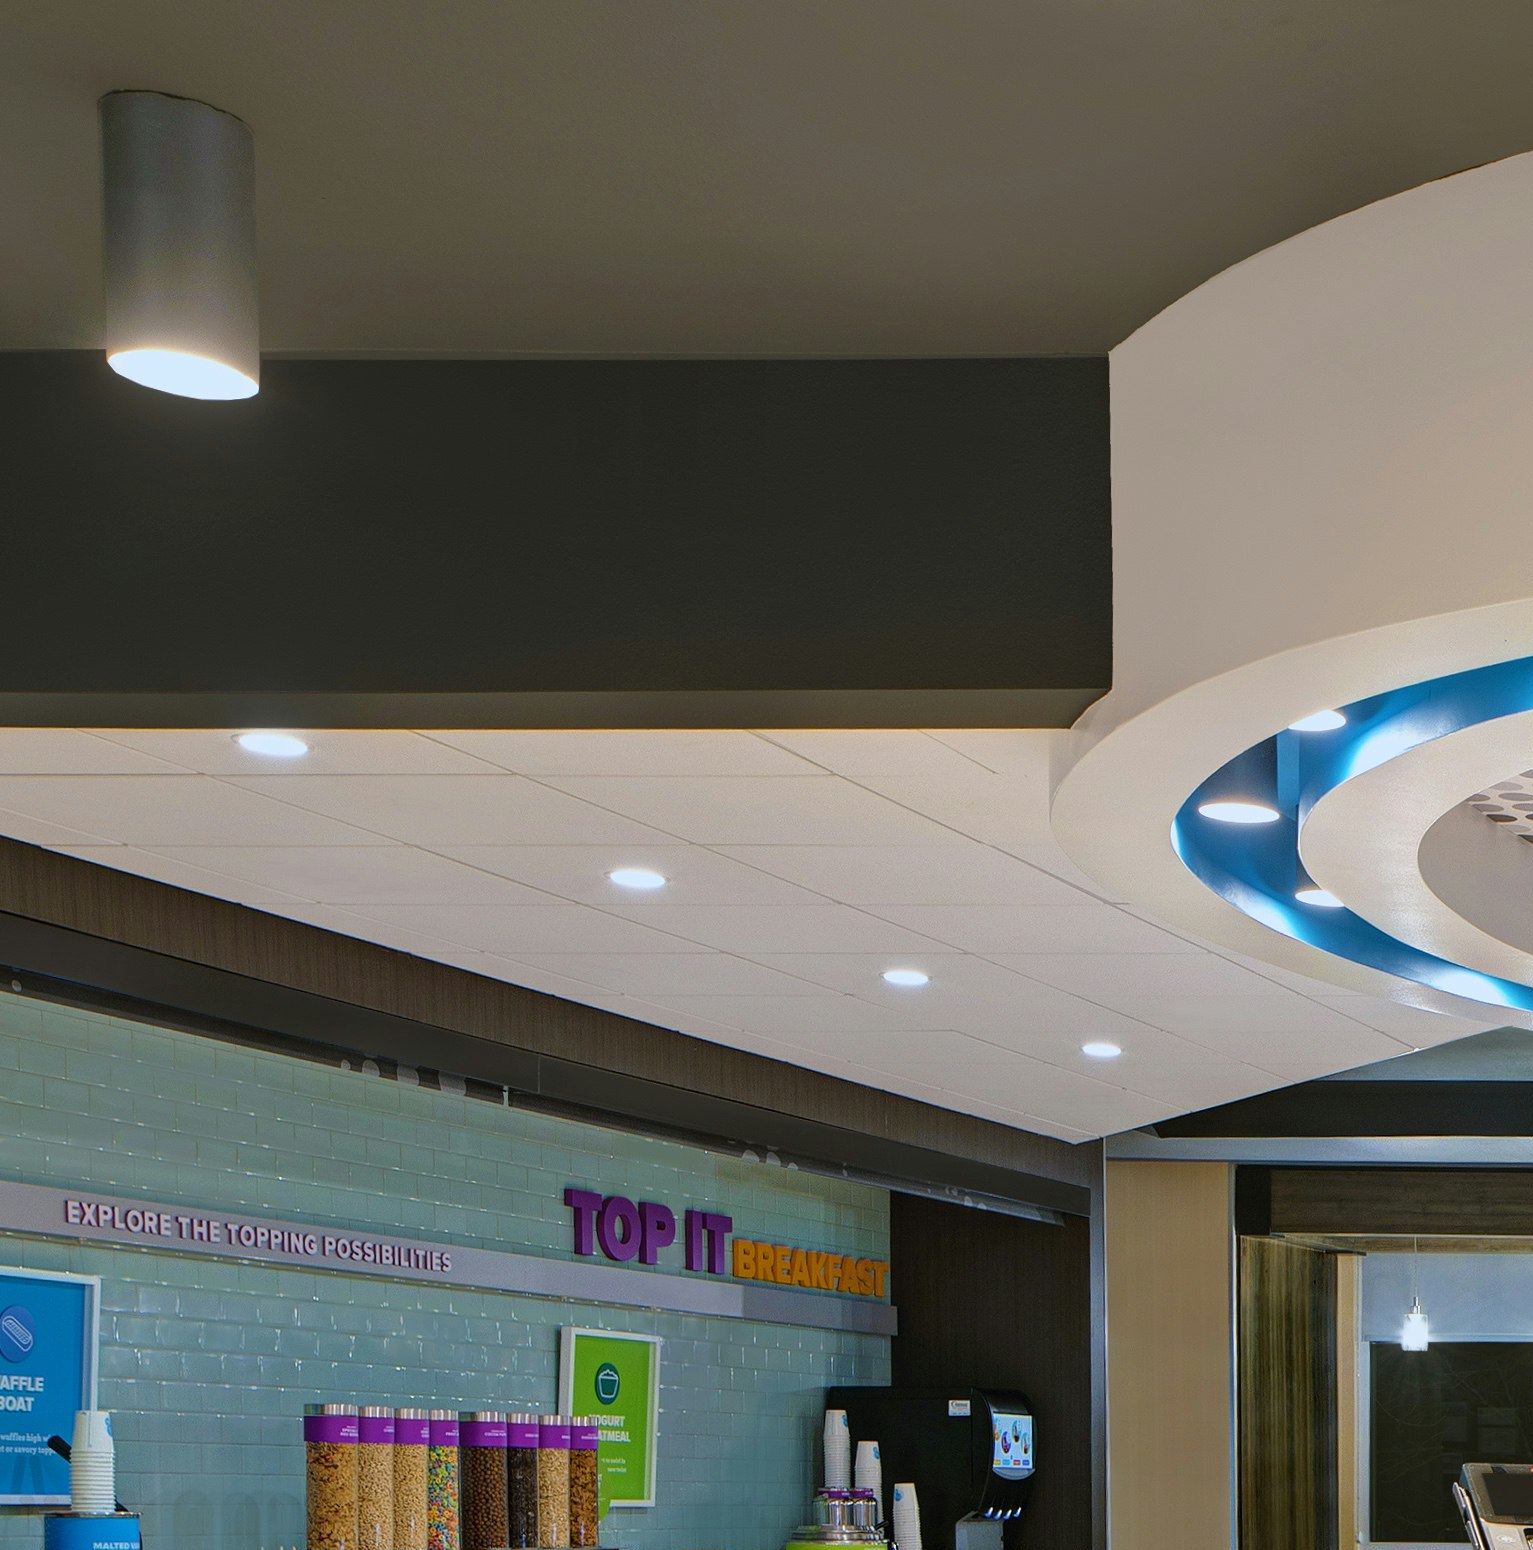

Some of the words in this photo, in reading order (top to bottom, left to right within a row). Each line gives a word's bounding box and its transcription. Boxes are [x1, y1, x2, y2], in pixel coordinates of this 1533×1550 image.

[65, 1200, 172, 1237] EXPLORE
[176, 1215, 221, 1244] THE
[227, 1222, 318, 1256] TOPPING
[321, 1236, 453, 1273] POSSIBILITIES
[564, 1188, 676, 1265] TOP
[685, 1209, 733, 1275] IT
[732, 1238, 889, 1298] BREAKFAST
[0, 1374, 45, 1392] AFFLE
[598, 1430, 631, 1443] ATMEAL
[93, 1542, 130, 1550] MALTED
